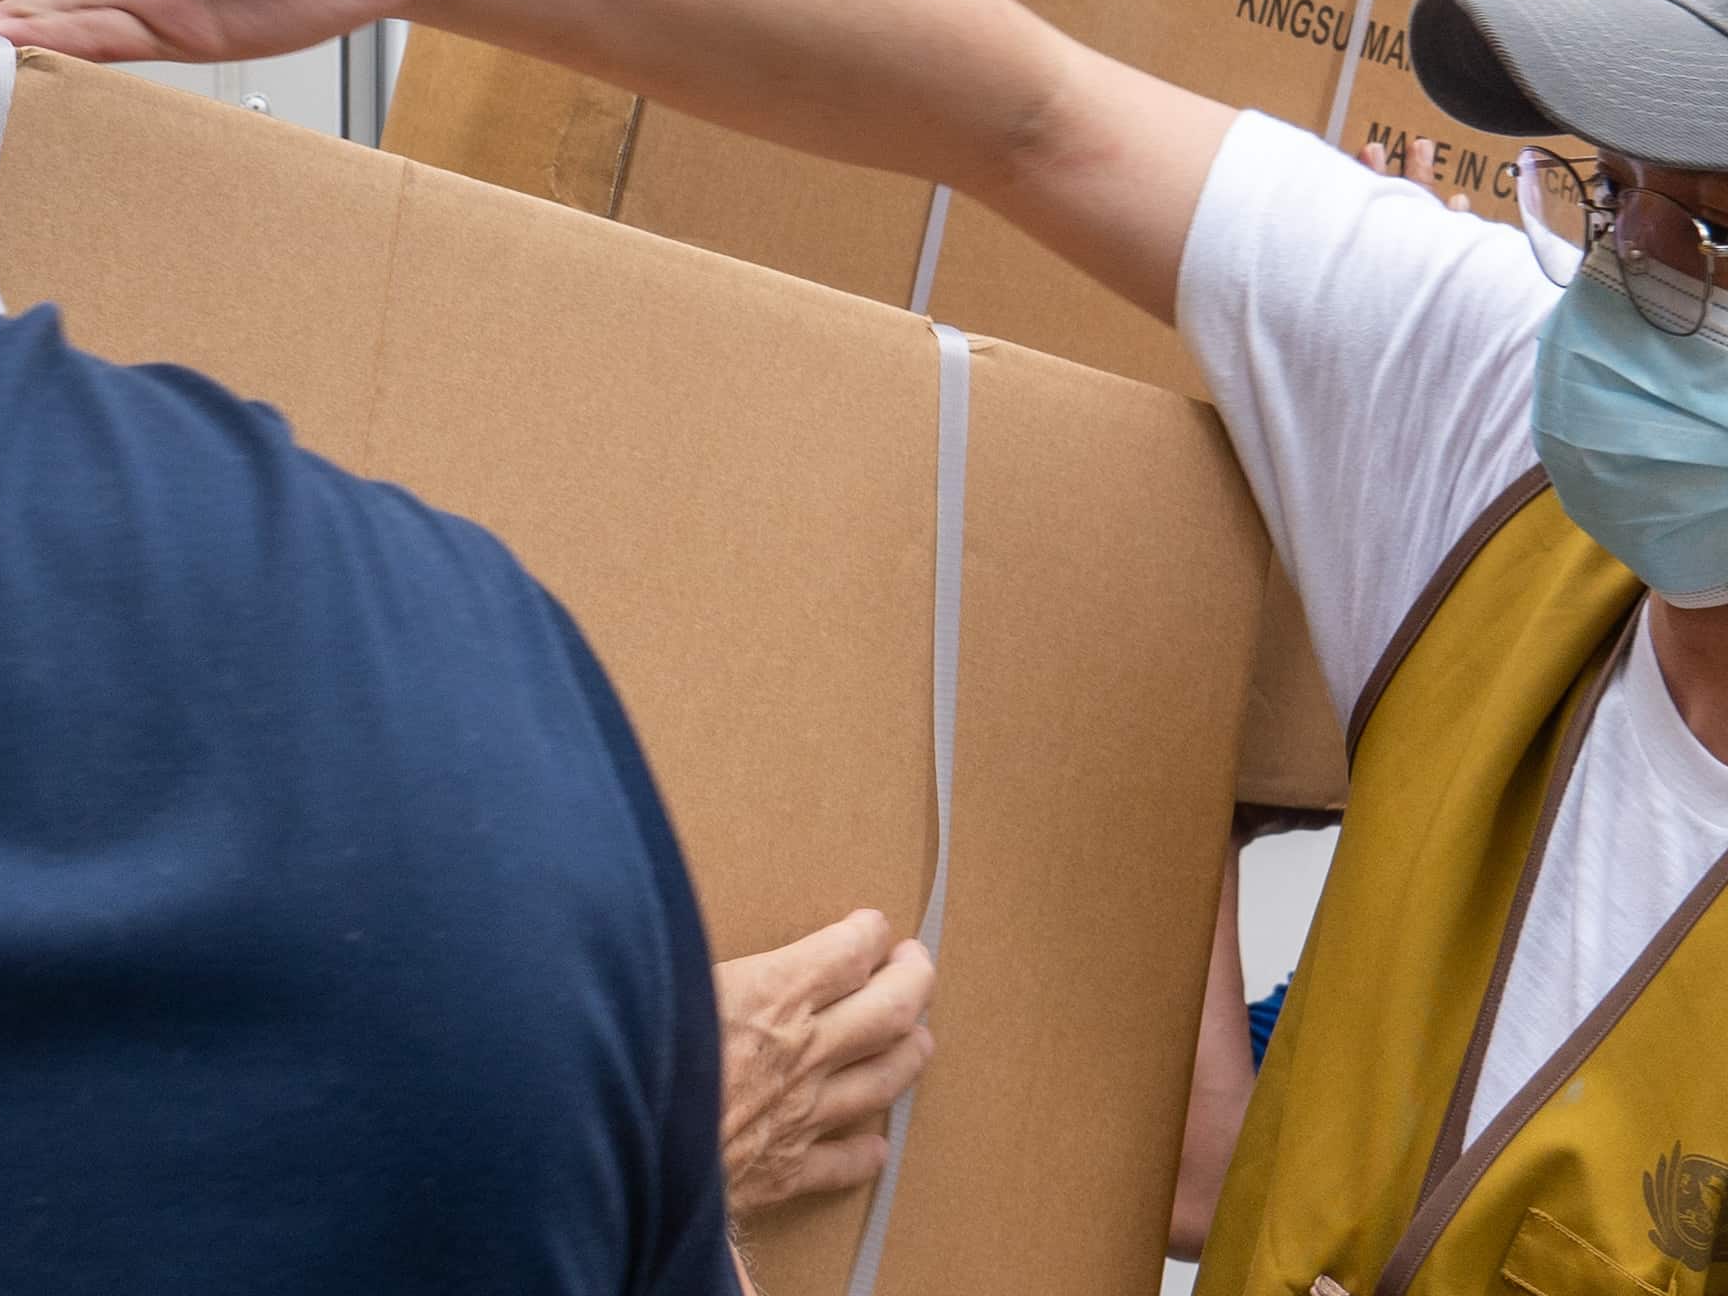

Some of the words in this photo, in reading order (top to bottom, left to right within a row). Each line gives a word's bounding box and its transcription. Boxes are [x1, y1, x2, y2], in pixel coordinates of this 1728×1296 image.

[1361, 21, 1410, 71] MA
[1368, 122, 1451, 180] MAE
[1454, 150, 1487, 192] IN
